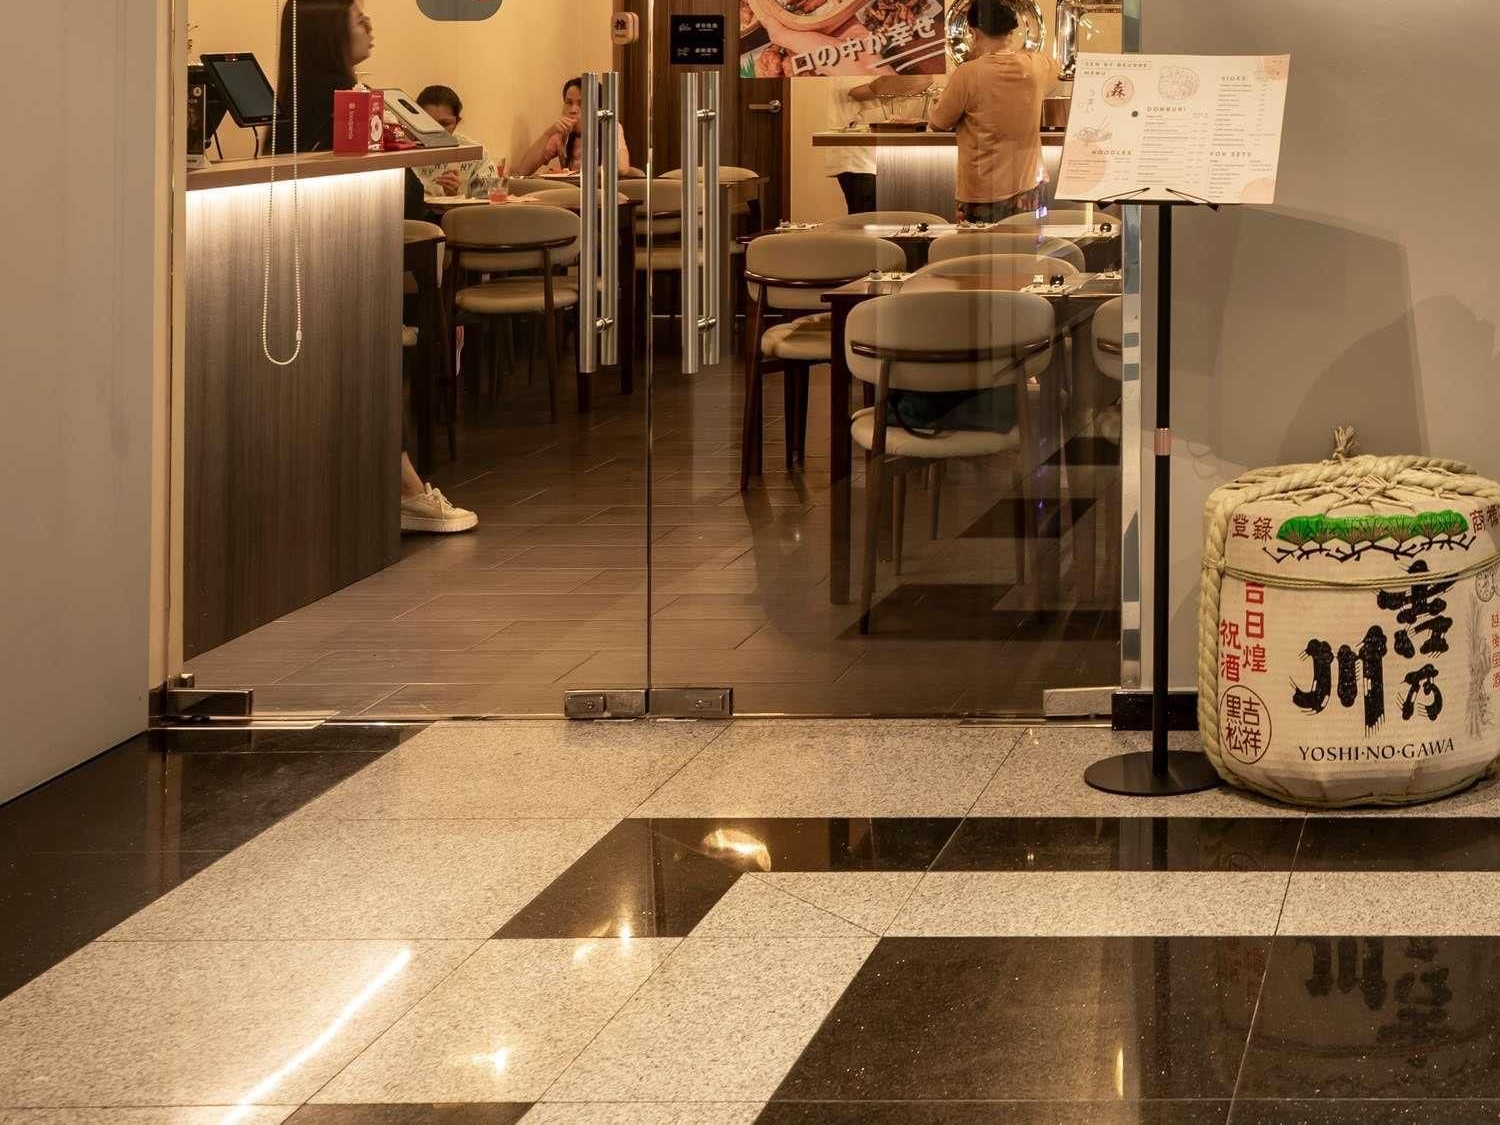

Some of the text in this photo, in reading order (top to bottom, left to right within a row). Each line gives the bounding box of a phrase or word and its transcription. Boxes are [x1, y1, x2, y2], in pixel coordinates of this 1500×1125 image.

[791, 17, 937, 76] 口の中が幸せ
[1219, 618, 1242, 683] 祝酒
